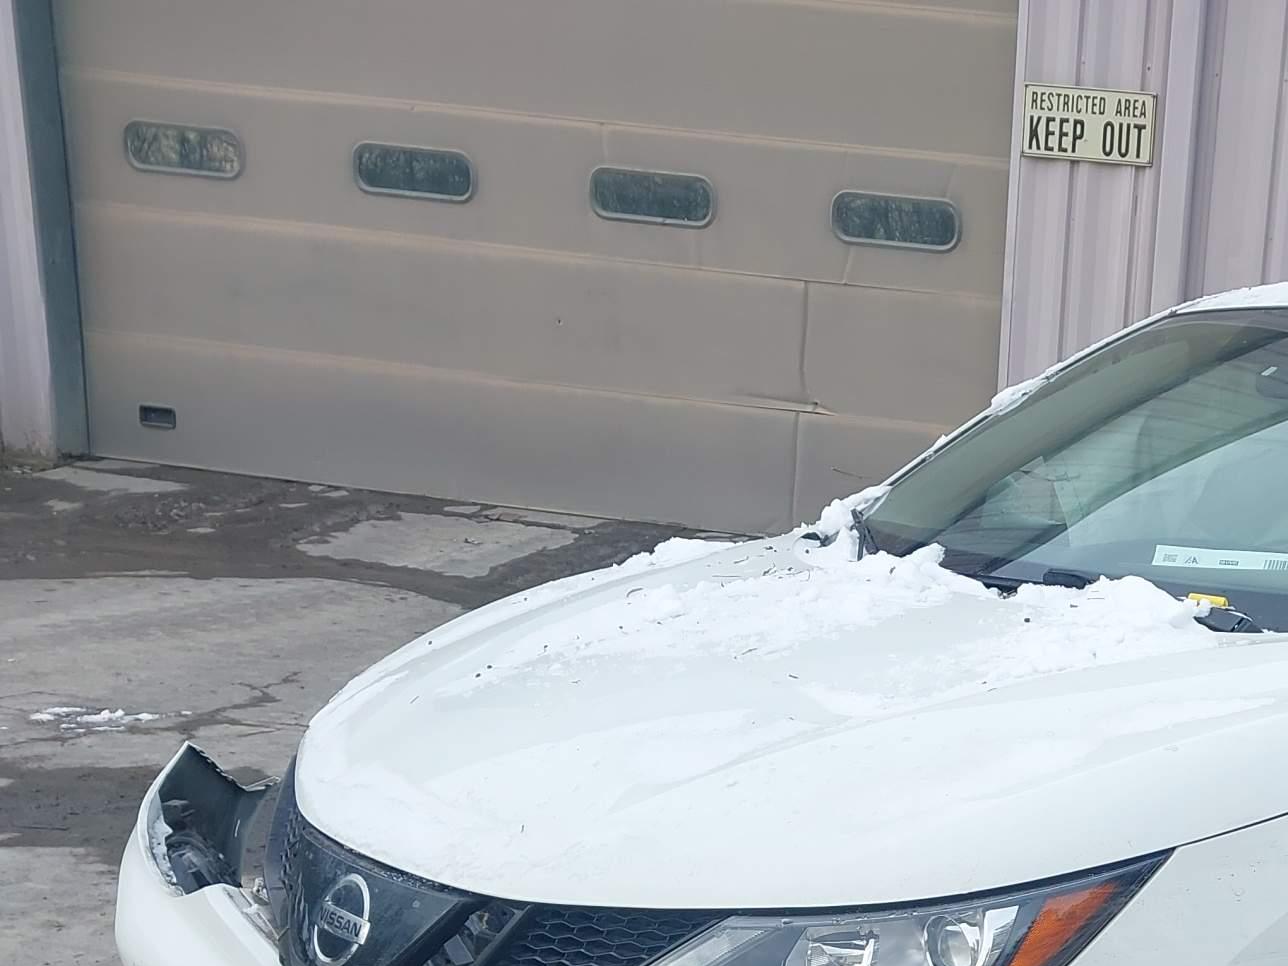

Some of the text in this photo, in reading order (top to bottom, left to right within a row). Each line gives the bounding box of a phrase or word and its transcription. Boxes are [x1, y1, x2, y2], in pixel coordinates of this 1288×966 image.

[1031, 91, 1147, 119] RESTRICTED AREA
[1028, 115, 1147, 159] KEEP OUT
[320, 906, 362, 938] NISSAN
